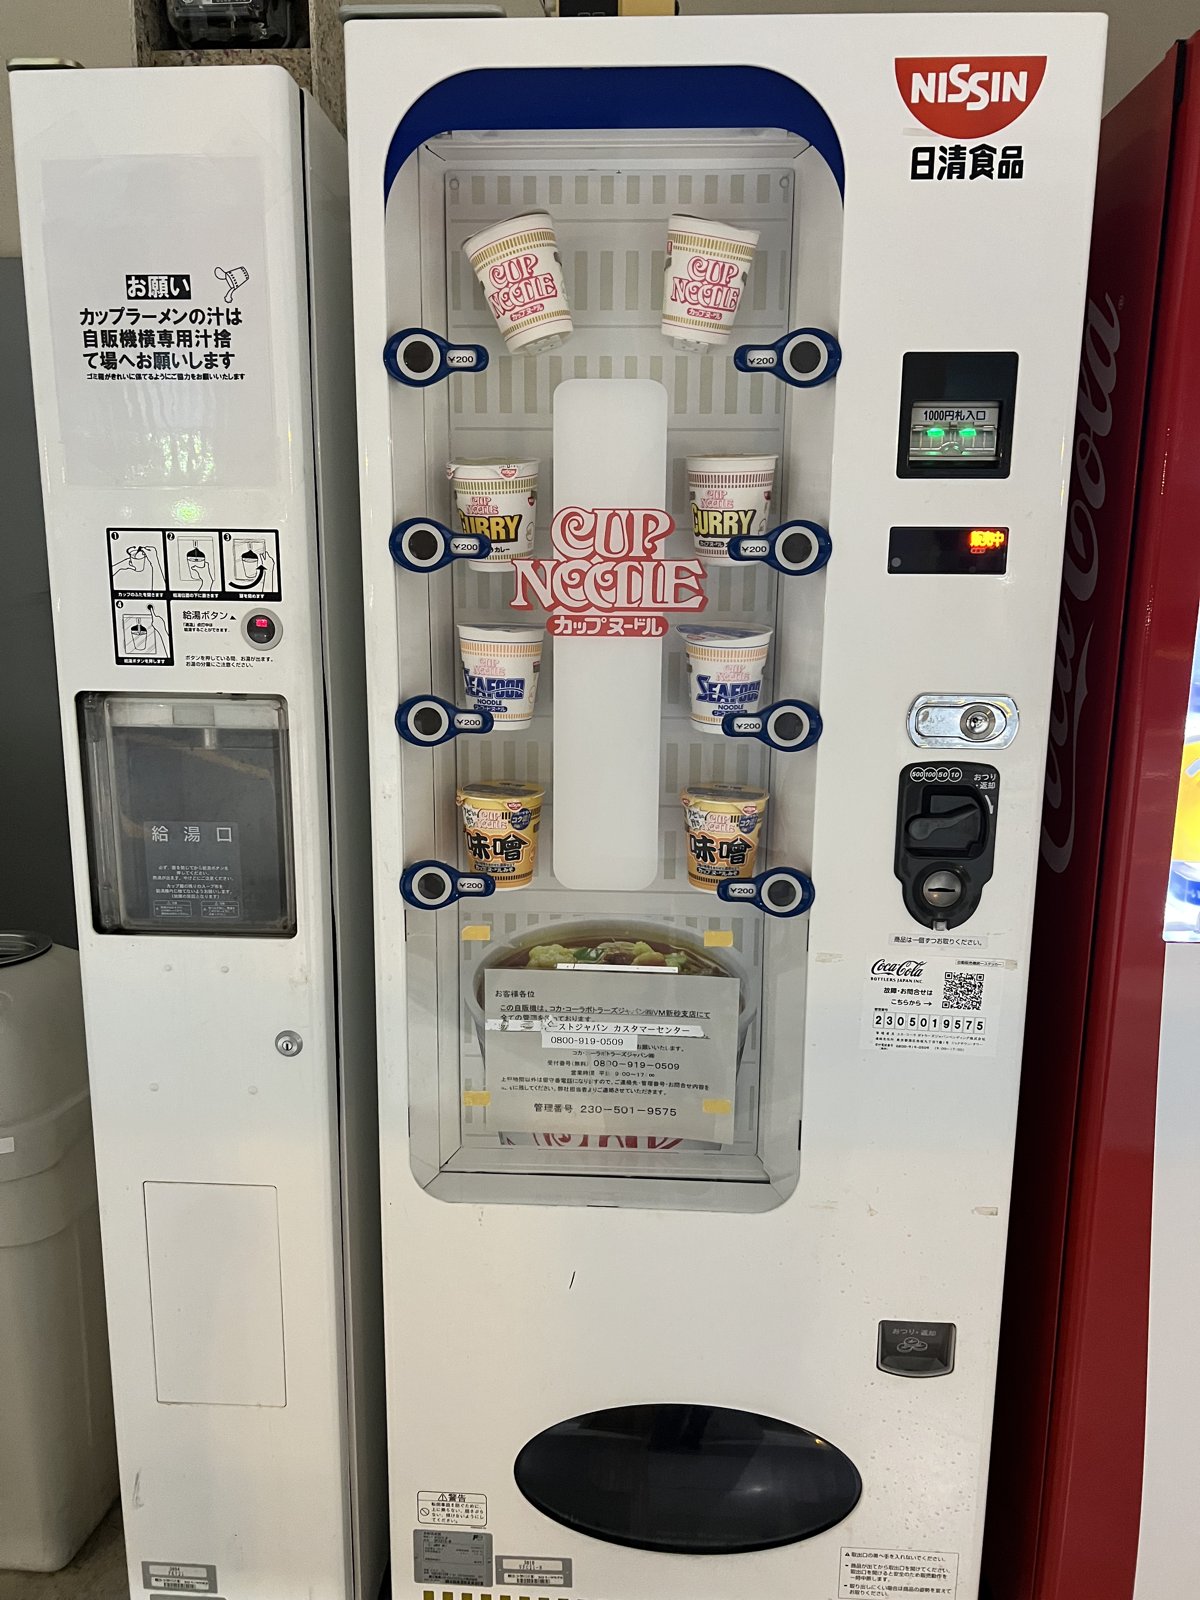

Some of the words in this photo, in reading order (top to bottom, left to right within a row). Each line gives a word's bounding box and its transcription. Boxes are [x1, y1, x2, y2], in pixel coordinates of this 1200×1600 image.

[911, 63, 1028, 111] NISSIN
[910, 143, 1024, 181] 日清食品
[488, 253, 539, 286] CUP
[687, 256, 740, 285] CUP
[127, 275, 190, 299] お願い
[488, 272, 558, 319] NOODLE
[671, 277, 741, 313] NOODLE
[80, 306, 243, 326] カップラーメンの汁は
[83, 329, 232, 349] 自販機横専用汁捨
[83, 351, 235, 371] て場へお願いします
[448, 355, 474, 363] ¥200
[748, 357, 775, 365] ¥200
[923, 409, 986, 421] 1000円札入口
[458, 508, 523, 544] CURRY
[691, 501, 757, 538] CURRY
[551, 505, 676, 562] CUP
[453, 543, 478, 551] ¥200
[741, 545, 767, 553] ¥200
[509, 558, 709, 614] NOODLE
[182, 610, 228, 620] 給湯ボタン
[553, 615, 663, 636] カップヌードル
[696, 674, 762, 704] SEAFOOD
[477, 698, 503, 706] NOODLE
[717, 703, 745, 711] NOODLE
[736, 722, 761, 730] ¥200
[973, 773, 997, 782] おつり
[730, 887, 754, 895] ¥200
[893, 935, 983, 947] 商品は一個ずつお取りください。
[871, 959, 928, 978] Coca-Cola
[495, 990, 535, 998] お客様各位
[613, 1025, 691, 1034] カスタマーセンター
[550, 1036, 624, 1046] 0800-919-0509
[534, 1103, 574, 1114] 管理番号
[580, 1105, 677, 1117] 230-501-9575
